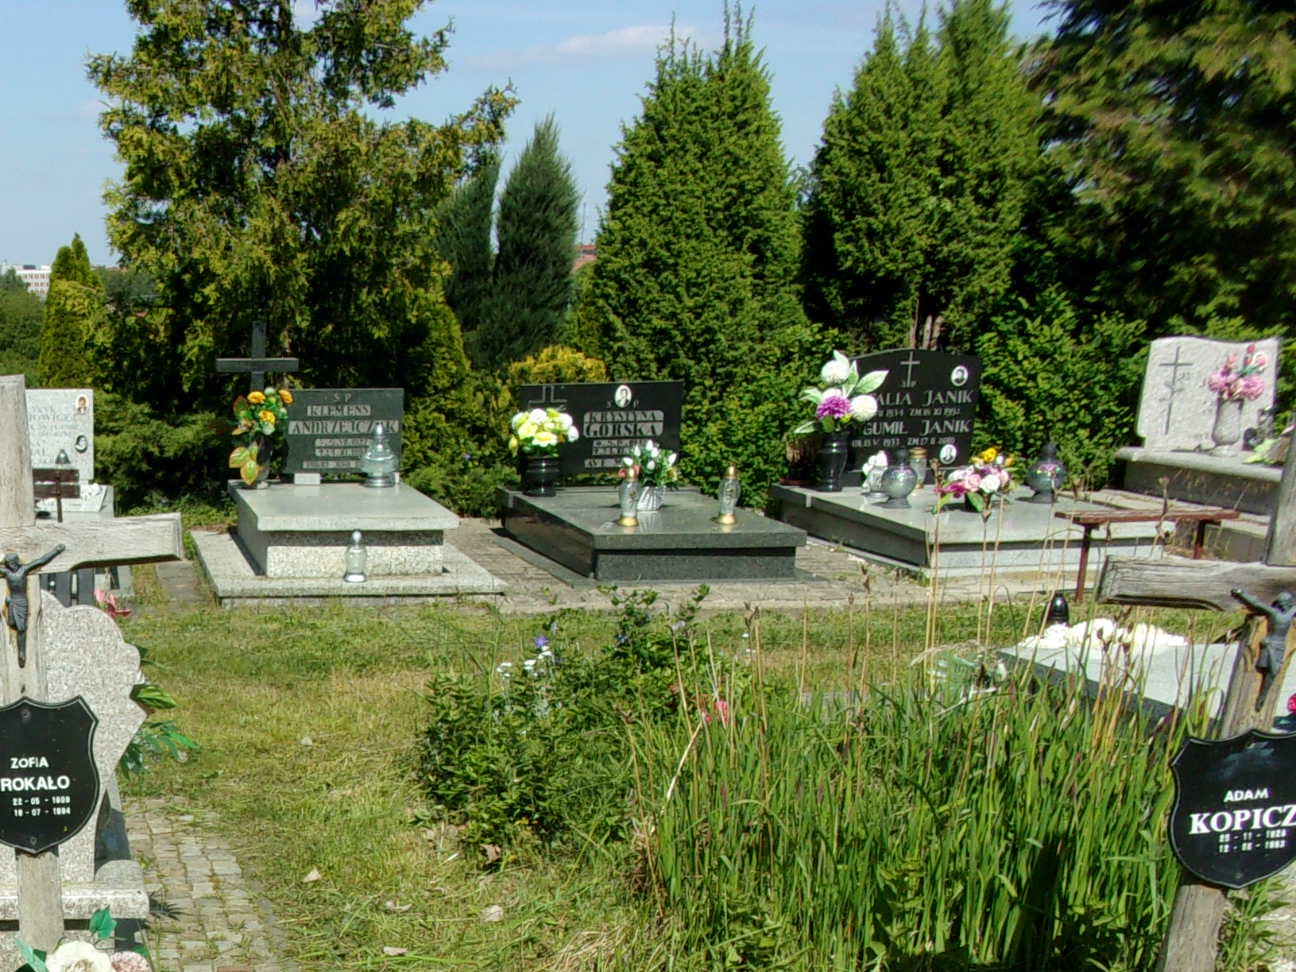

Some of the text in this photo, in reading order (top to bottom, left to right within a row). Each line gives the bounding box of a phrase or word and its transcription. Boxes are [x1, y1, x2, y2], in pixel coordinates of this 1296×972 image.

[921, 390, 974, 407] JANIK
[310, 405, 370, 416] KLEMENS
[588, 411, 658, 423] KRYSTYNA
[920, 419, 972, 436] JANIK
[10, 756, 49, 769] ZOFIA
[1224, 788, 1270, 803] ADAM
